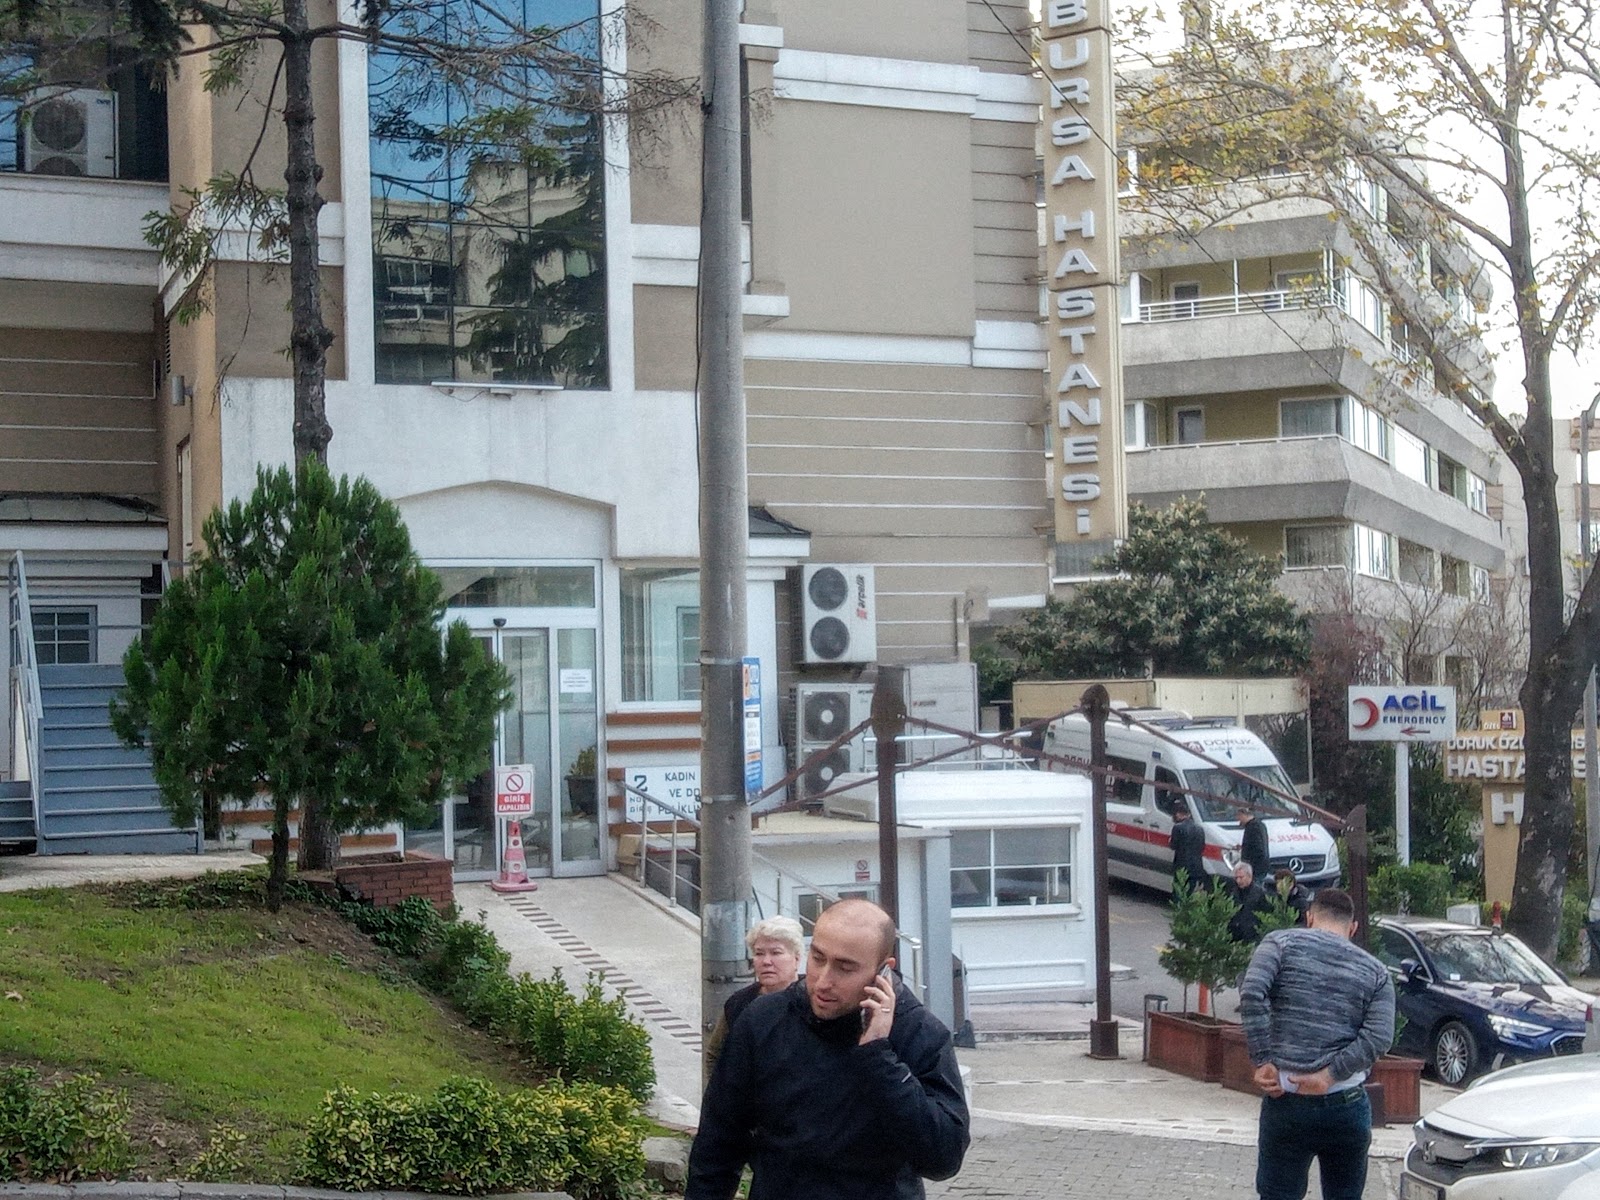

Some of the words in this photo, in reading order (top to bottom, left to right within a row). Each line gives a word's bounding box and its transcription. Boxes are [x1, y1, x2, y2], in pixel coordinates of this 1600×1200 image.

[1047, 0, 1096, 186] BURSA
[1054, 209, 1102, 535] HASTANESİ
[1382, 690, 1446, 712] ACİL
[1382, 715, 1447, 725] EMERGENCY
[665, 771, 696, 781] KADIN
[634, 775, 648, 792] 2
[504, 795, 525, 803] GİRİŞ
[669, 788, 682, 798] VE
